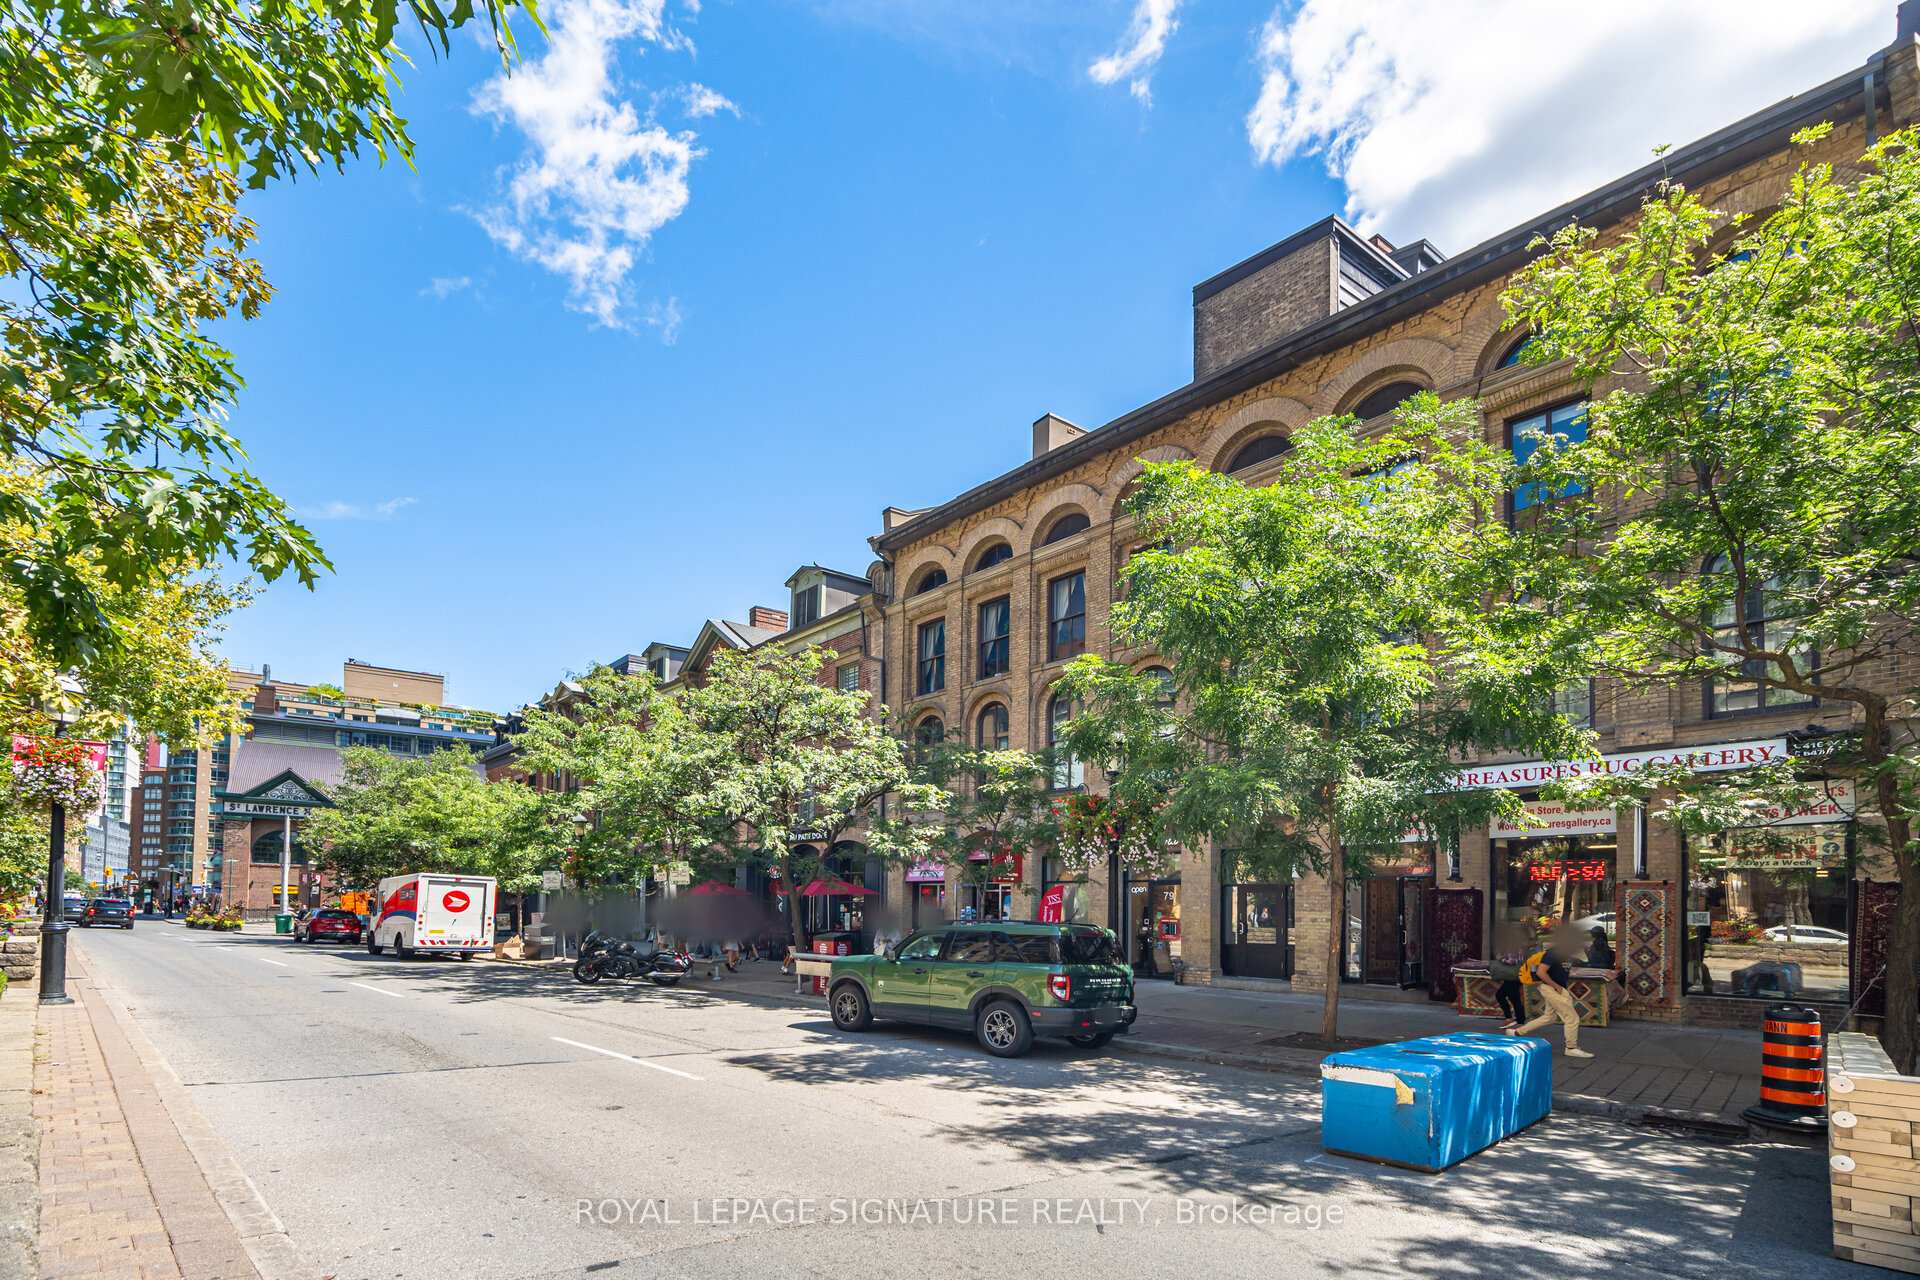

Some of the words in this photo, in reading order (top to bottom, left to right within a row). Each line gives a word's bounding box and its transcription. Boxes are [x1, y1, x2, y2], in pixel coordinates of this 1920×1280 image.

[1456, 763, 1581, 787] TREASURES
[1649, 745, 1776, 769] GALLERY
[245, 804, 299, 815] LAWRENCE
[1537, 806, 1561, 815] Store
[1797, 803, 1839, 817] WEEK
[1497, 816, 1611, 831] Wovetreauresgallery.ca
[1745, 859, 1770, 868] Days
[1782, 858, 1812, 867] Week
[1131, 886, 1147, 895] open
[1163, 891, 1175, 900] 79
